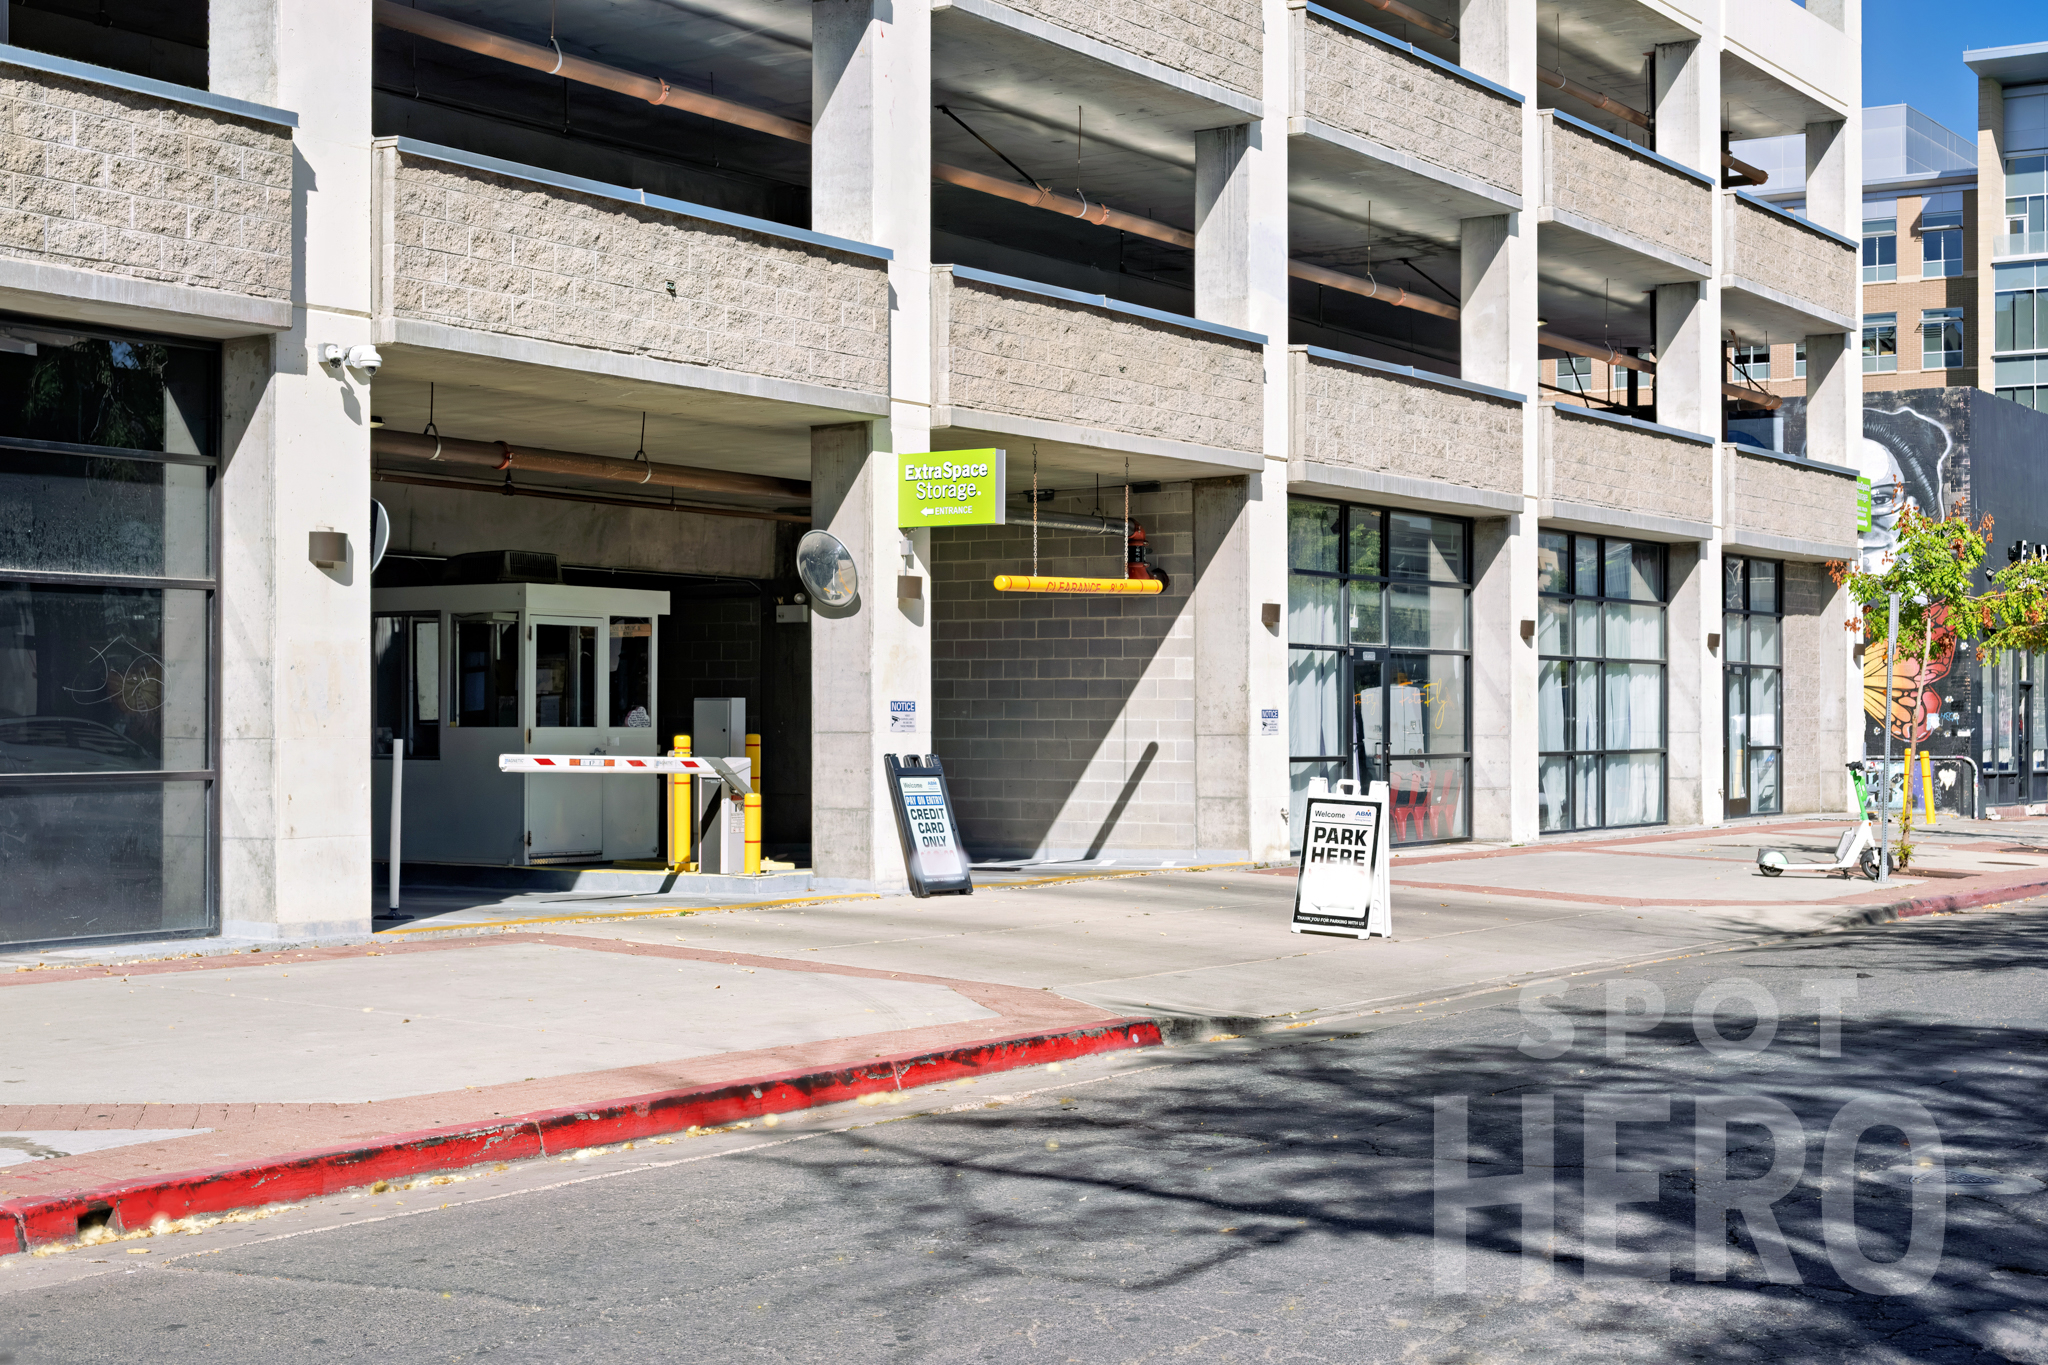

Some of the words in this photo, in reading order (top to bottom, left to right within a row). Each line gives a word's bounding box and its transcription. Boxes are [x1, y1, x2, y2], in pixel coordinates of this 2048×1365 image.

[935, 506, 972, 515] ENTRANCE
[1045, 582, 1101, 592] CLEARANCE
[892, 702, 914, 711] NOTICE
[1261, 710, 1278, 718] NOTICE
[905, 796, 916, 805] PAY
[917, 796, 926, 805] ON
[926, 795, 944, 804] ENTRY
[910, 808, 945, 820] CREDIT
[1315, 810, 1346, 818] Welcome
[918, 823, 944, 833] CARD
[923, 836, 946, 847] ONLY
[1314, 827, 1368, 846] PARK
[1311, 847, 1366, 866] HERE
